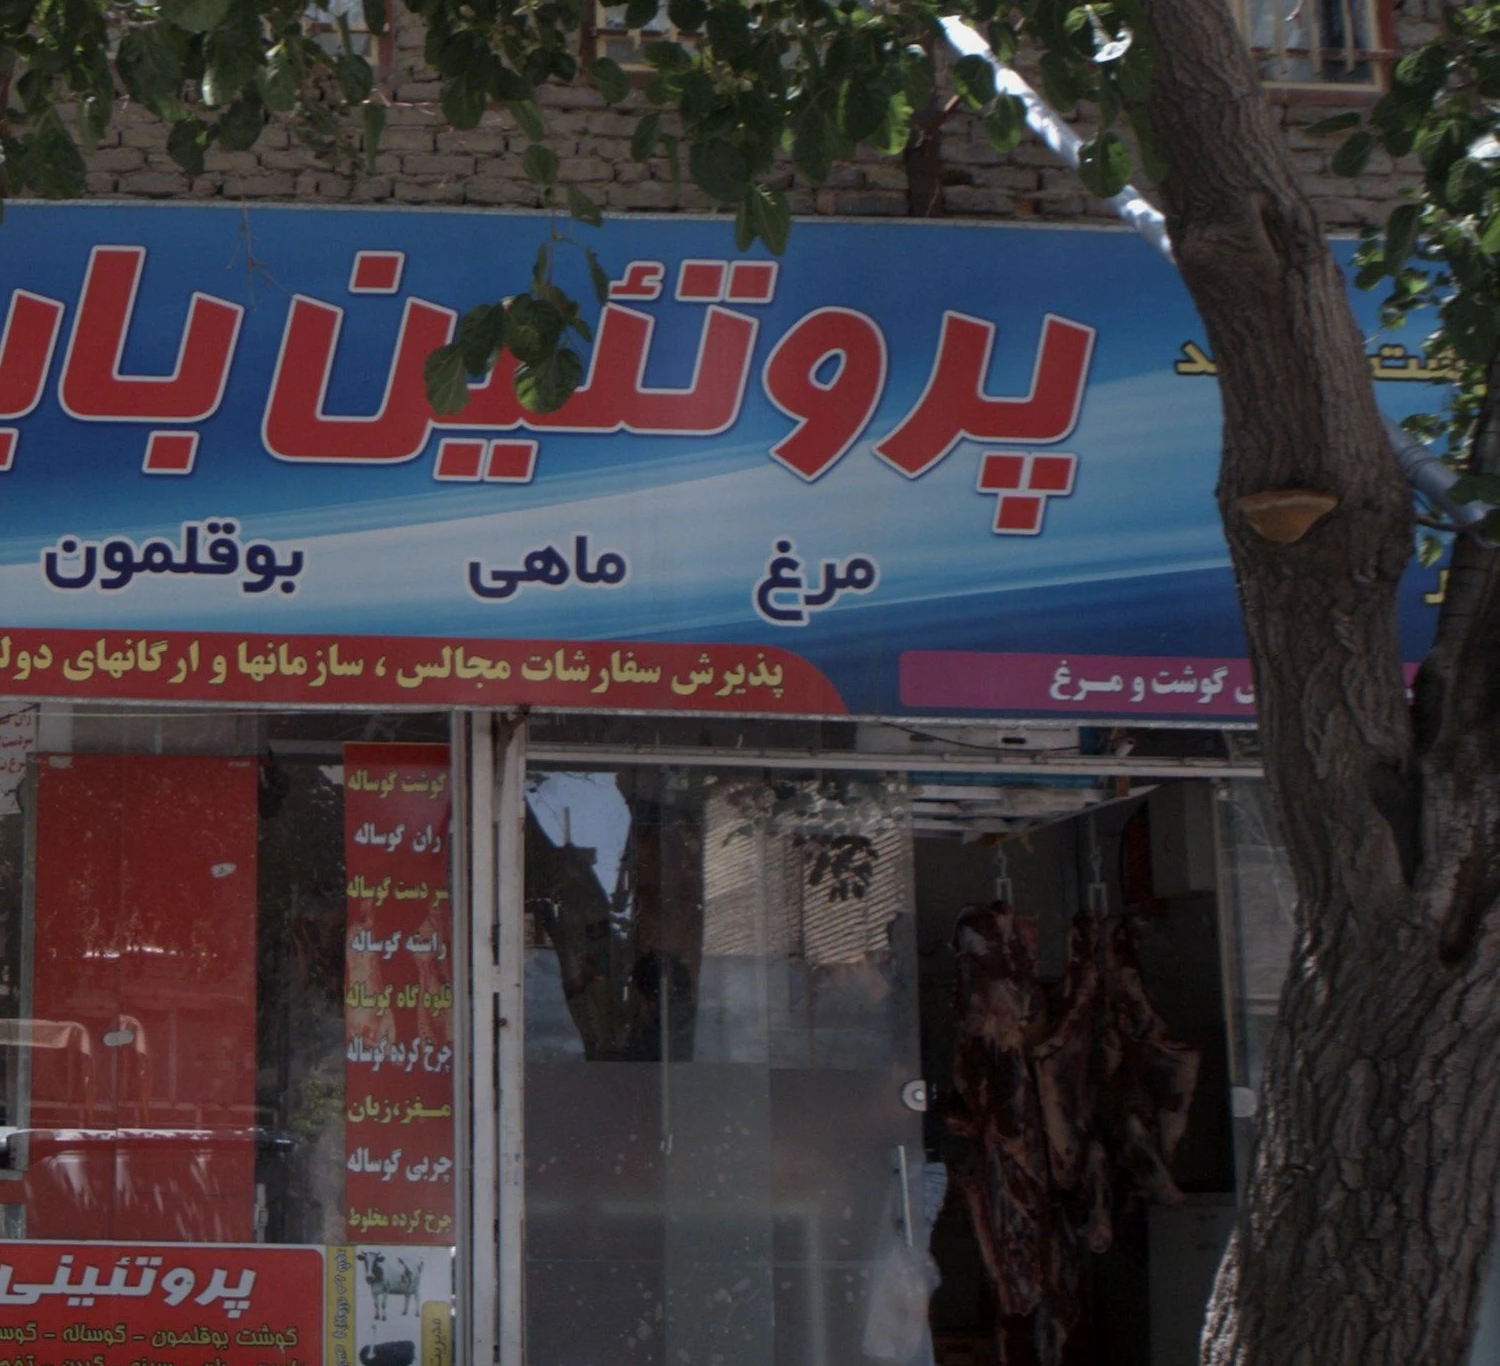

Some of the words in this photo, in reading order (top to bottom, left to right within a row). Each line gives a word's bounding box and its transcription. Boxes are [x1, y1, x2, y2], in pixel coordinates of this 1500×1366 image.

[262, 250, 1096, 535] پروتئین
[43, 517, 304, 594] بوقلمون
[468, 535, 628, 600] ماهی
[755, 536, 879, 625] مرغ
[62, 634, 198, 683] ارگانهای
[211, 653, 227, 683] و
[237, 637, 363, 687] سازمانها
[396, 640, 512, 687] مجالس
[521, 643, 661, 694] سفارشات
[669, 647, 783, 698] پذیرش
[1131, 674, 1145, 702] و
[1151, 666, 1229, 704] گوشت
[348, 769, 397, 798] گوساله
[402, 771, 447, 799] گوشت
[353, 822, 405, 852] گوساله
[412, 824, 442, 853] ران
[347, 876, 391, 906] گوساله
[351, 930, 402, 960] گوساله
[405, 931, 447, 960] راسته
[345, 982, 392, 1016] گوساله
[346, 1036, 389, 1072] گوساله
[346, 1147, 403, 1182] گوساله
[405, 1152, 452, 1182] چربی
[348, 1206, 389, 1233] مخلوط
[151, 1324, 230, 1350] بوقلمون
